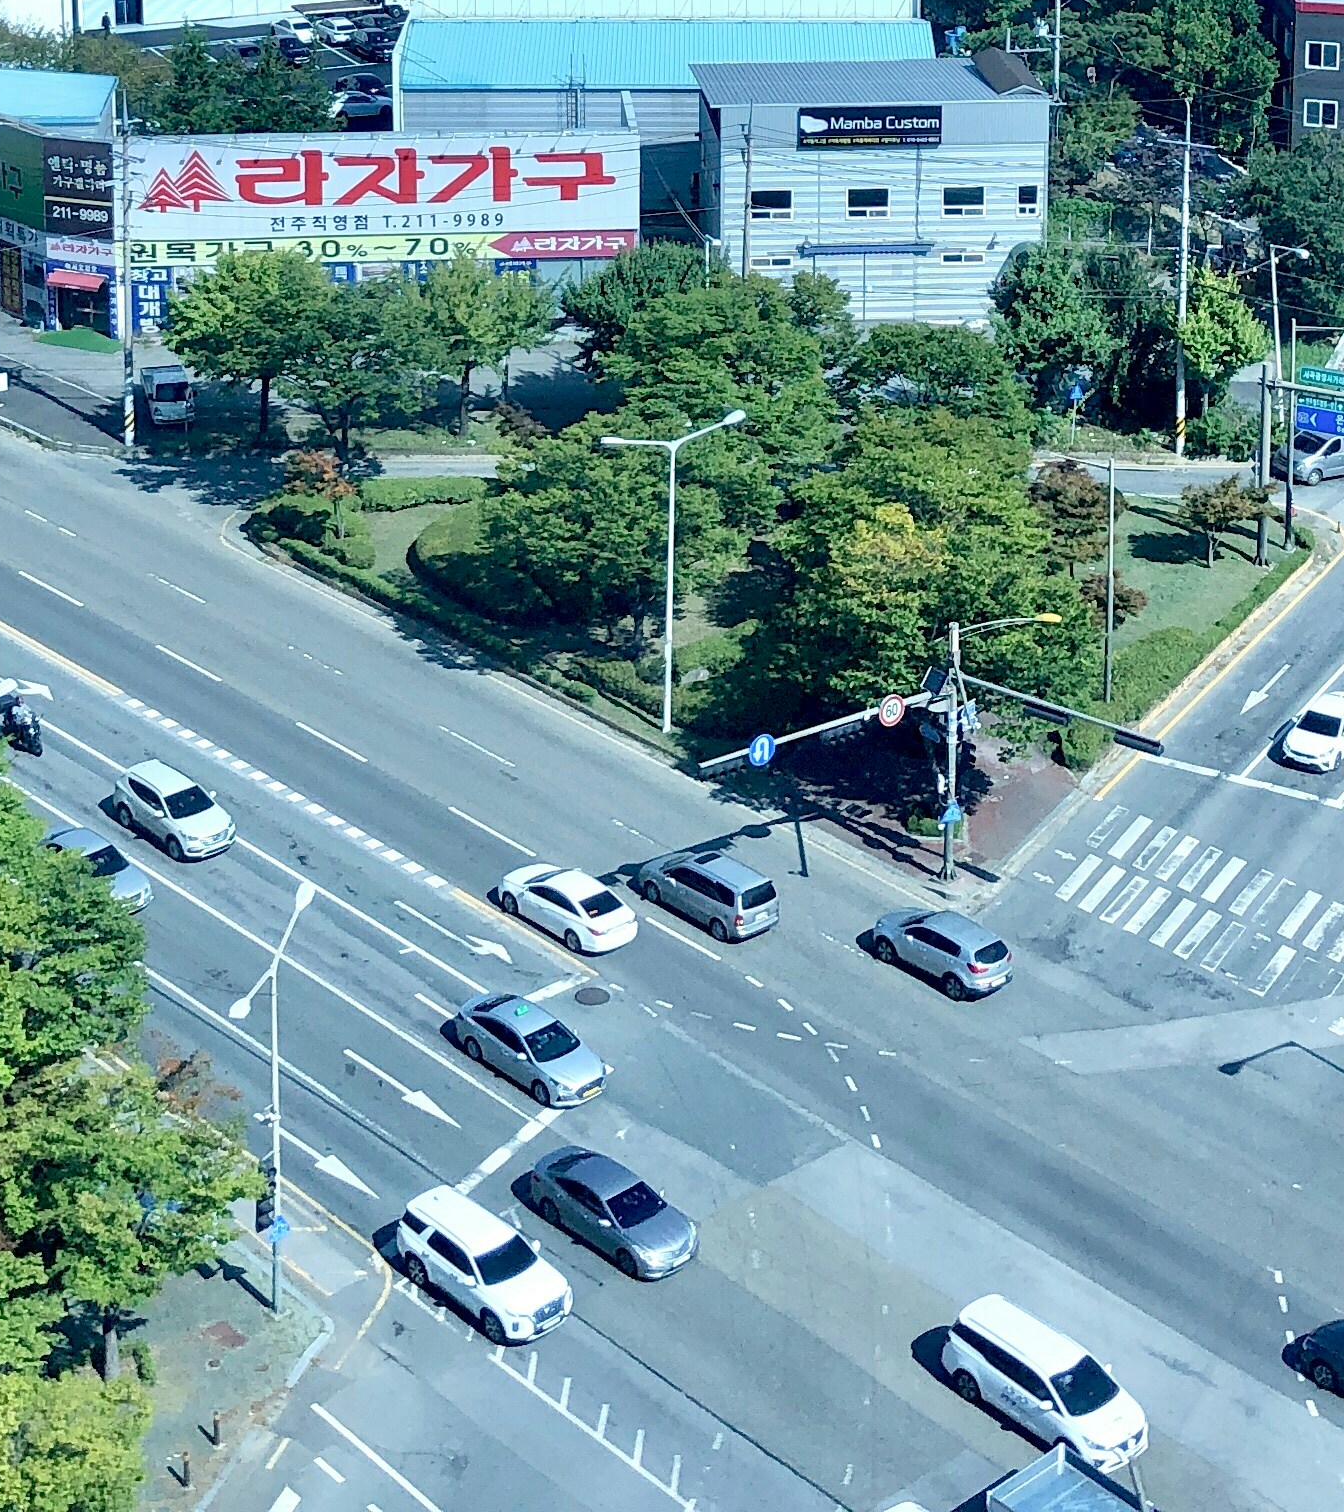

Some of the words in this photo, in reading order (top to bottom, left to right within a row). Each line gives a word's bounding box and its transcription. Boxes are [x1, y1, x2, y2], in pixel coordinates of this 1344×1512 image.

[830, 116, 883, 130] Mamba
[886, 115, 940, 129] Custom
[235, 146, 616, 206] 라자가구
[52, 205, 109, 223] 211-9989
[270, 215, 370, 232] 전주직영점
[383, 213, 505, 229] T.211-9989
[533, 236, 627, 252] 라자가구
[138, 285, 161, 334] 대개방
[885, 703, 899, 718] 60
